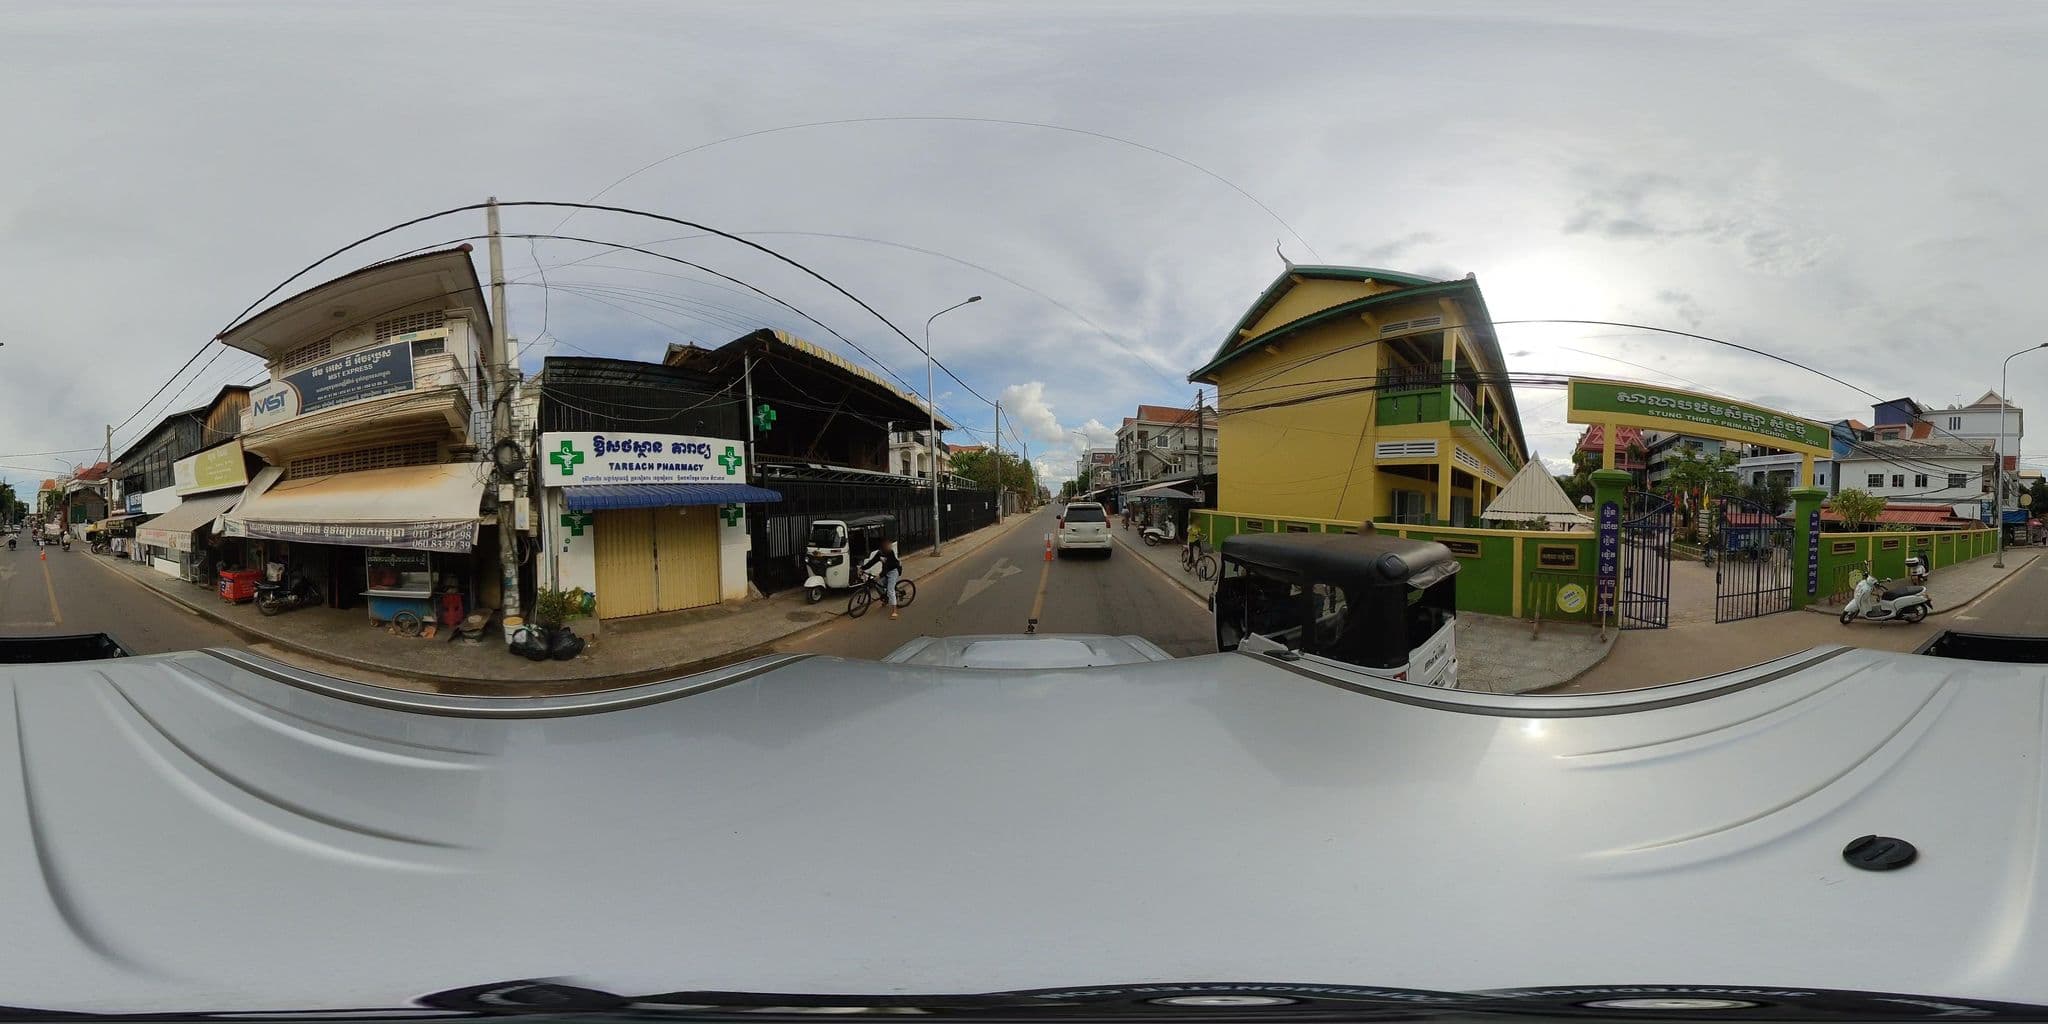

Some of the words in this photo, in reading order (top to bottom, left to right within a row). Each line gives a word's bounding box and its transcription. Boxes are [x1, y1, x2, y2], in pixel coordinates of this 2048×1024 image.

[328, 373, 341, 381] MST
[342, 364, 373, 377] EXPRESS
[254, 389, 288, 416] MST
[1648, 409, 1683, 420] STUNG
[1686, 415, 1719, 426] THMEY
[1721, 420, 1760, 433] PRIMARY
[1760, 428, 1788, 439] SCHOOL
[608, 462, 655, 472] TAREACH
[656, 462, 704, 472] PHARMACY
[412, 530, 429, 538] 010
[431, 531, 443, 539] 81
[446, 531, 457, 539] 91
[460, 531, 472, 540] 98
[412, 539, 429, 548] 060
[431, 540, 442, 548] 83
[445, 540, 456, 548] 89
[459, 541, 471, 550] 39
